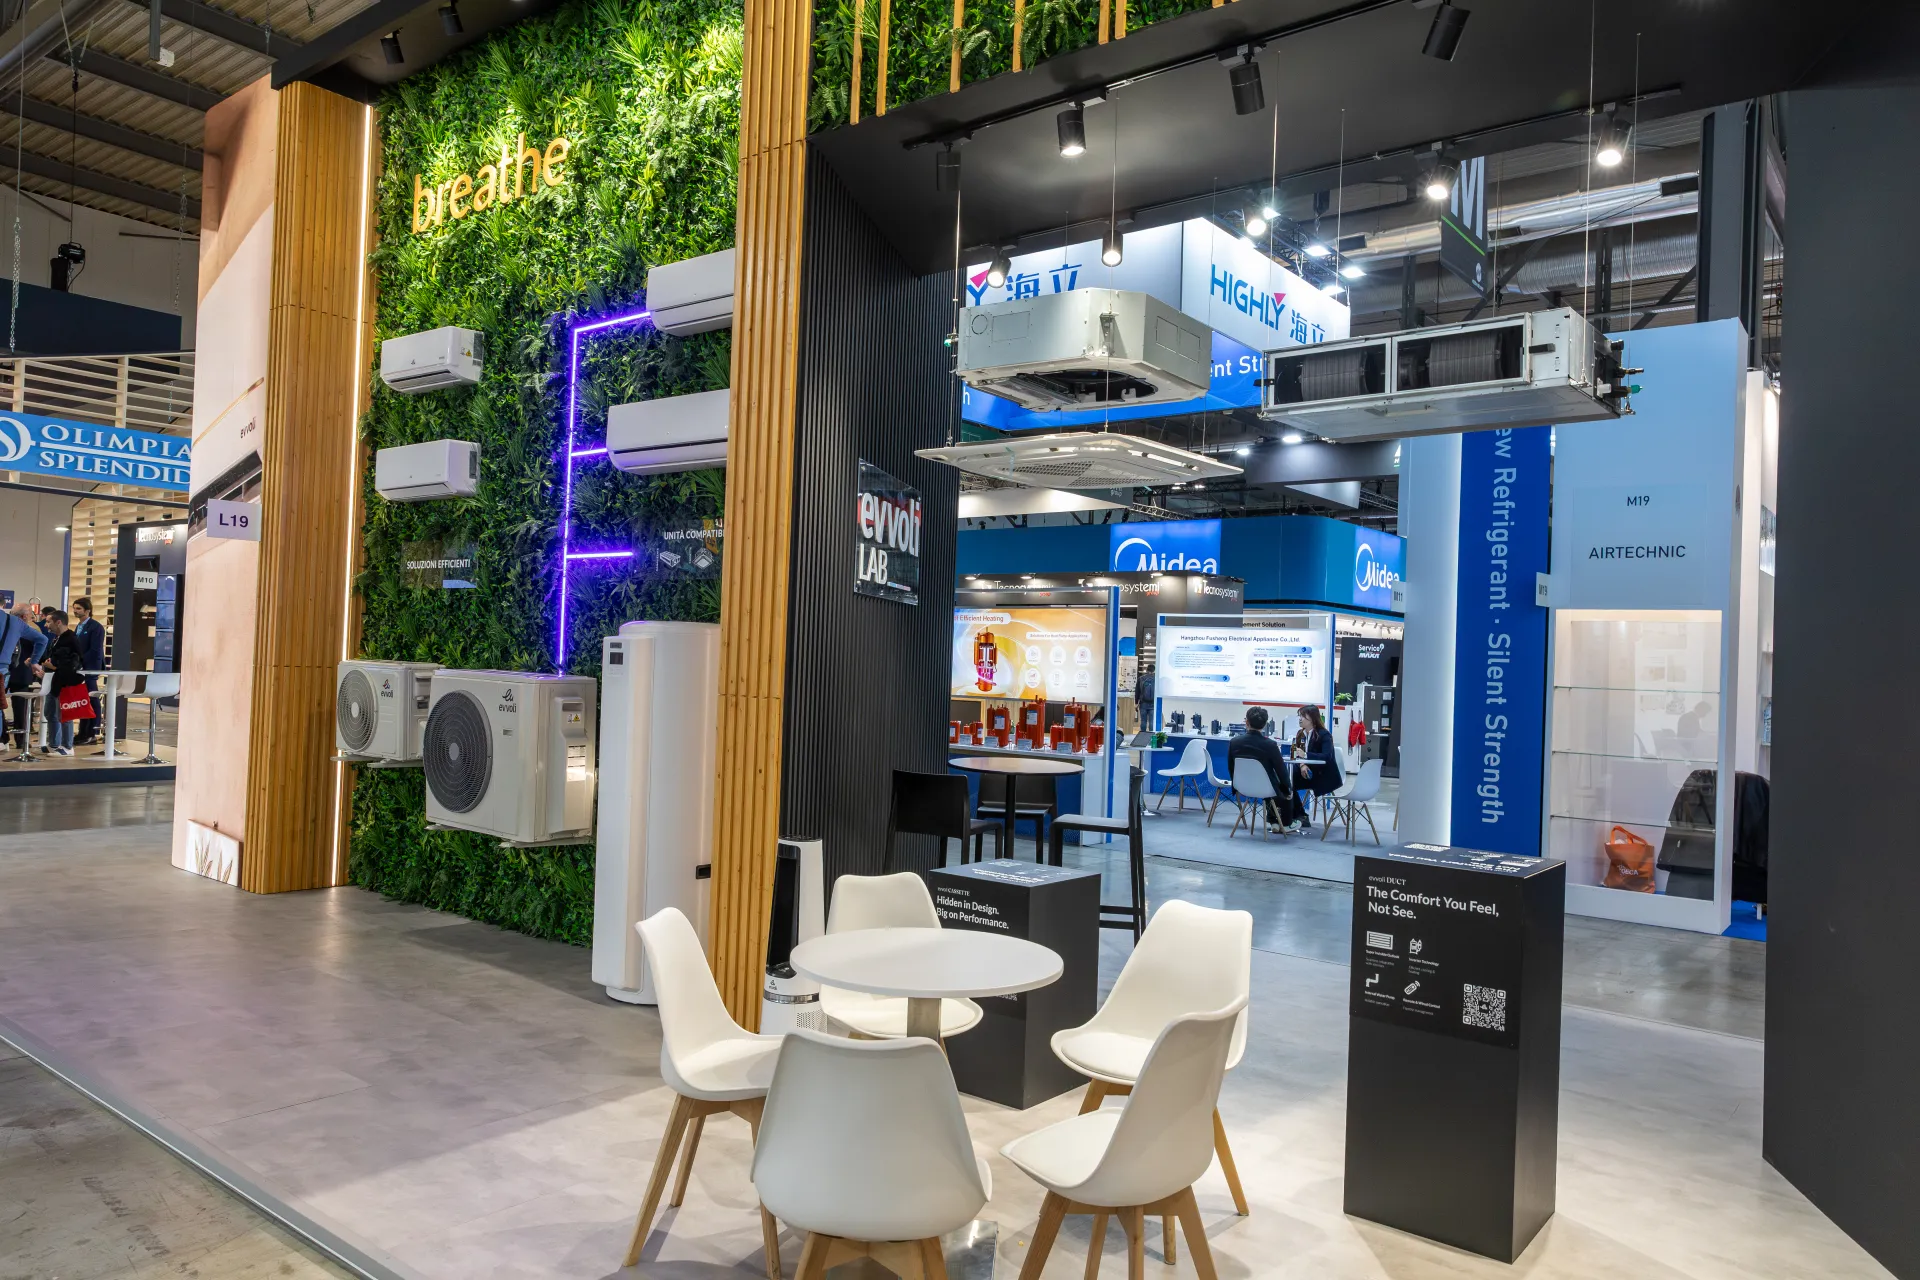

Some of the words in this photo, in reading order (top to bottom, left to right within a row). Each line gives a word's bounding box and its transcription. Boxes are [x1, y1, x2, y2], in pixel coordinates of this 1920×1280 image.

[412, 132, 571, 234] breathe
[1210, 263, 1286, 331] HIGHLY
[41, 424, 191, 460] OLIMPIA
[1626, 495, 1650, 507] M19
[219, 512, 249, 528] L19
[860, 492, 919, 557] evvoli
[663, 529, 685, 540] UNITÀ
[1486, 467, 1517, 610] Refrigerant
[1136, 552, 1218, 575] Midea
[1588, 545, 1687, 560] AIRTECHNIC
[406, 560, 437, 570] SOLUZIONI
[437, 558, 471, 569] EFFICIENTI
[858, 543, 888, 585] LAB
[137, 576, 153, 584] M10
[960, 612, 982, 622] Efficient
[982, 613, 1004, 623] Heating
[1358, 644, 1380, 652] Service
[1486, 632, 1511, 705] Silent
[498, 703, 517, 713] evvoli
[1476, 713, 1508, 824] Strength
[1386, 876, 1407, 886] DUCT
[936, 894, 963, 909] Hidden
[963, 899, 971, 910] in
[972, 901, 999, 916] Design.
[1366, 885, 1388, 899] The
[1390, 889, 1441, 907] Comfort
[1443, 896, 1467, 911] You
[1469, 900, 1500, 918] Feel,
[1368, 901, 1391, 915] Not
[1392, 905, 1417, 919] See.
[936, 907, 949, 920] Big
[949, 911, 959, 920] on
[959, 911, 1010, 930] Performance.
